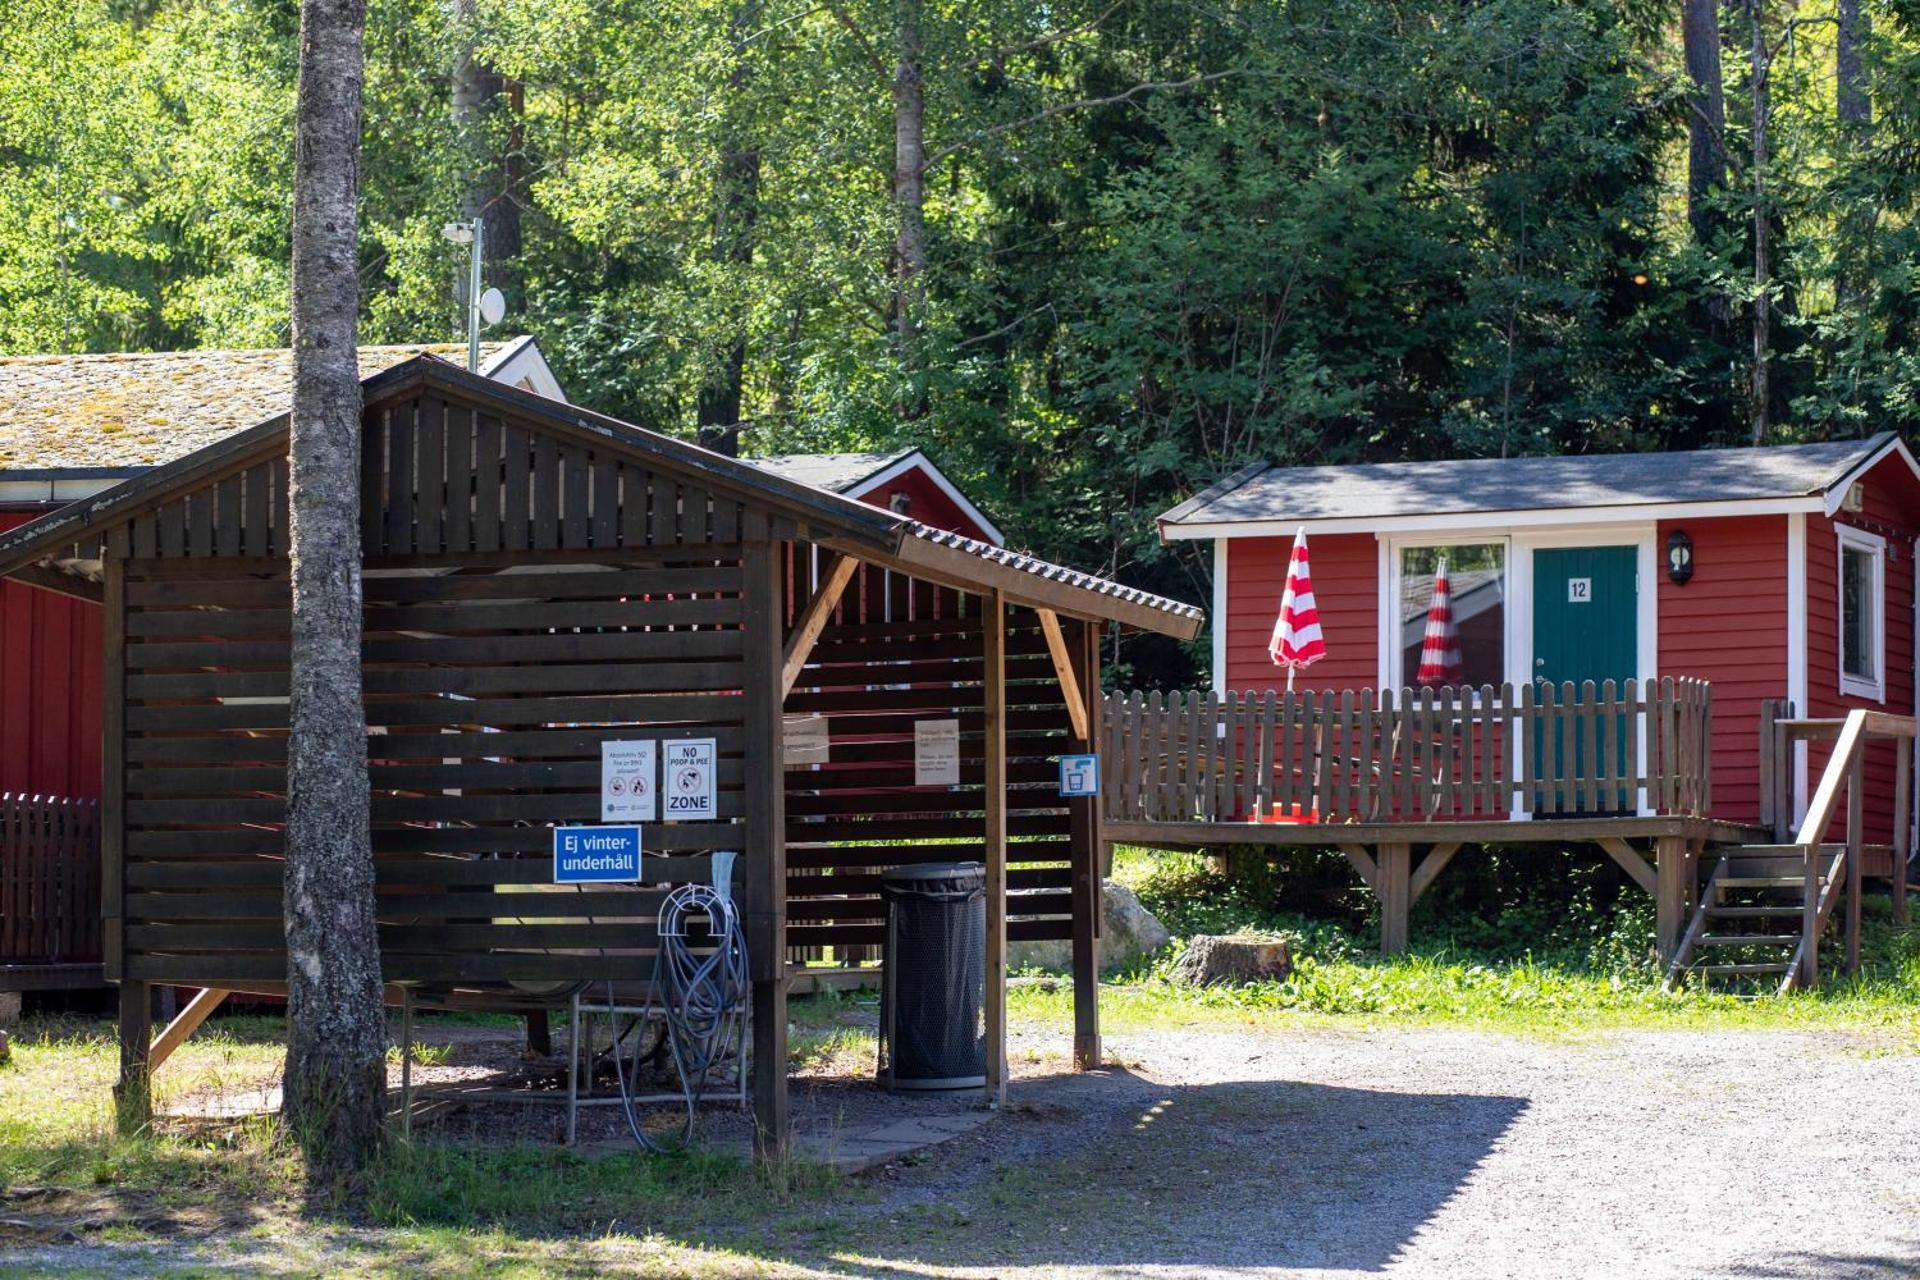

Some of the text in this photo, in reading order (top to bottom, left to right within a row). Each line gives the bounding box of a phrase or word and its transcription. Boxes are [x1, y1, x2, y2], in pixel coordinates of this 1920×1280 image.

[1572, 582, 1586, 597] 12
[682, 747, 697, 758] NO
[696, 757, 708, 765] PEE
[670, 796, 708, 809] ZONE
[565, 835, 631, 855] Ej vinter-
[563, 854, 633, 870] underhåll
